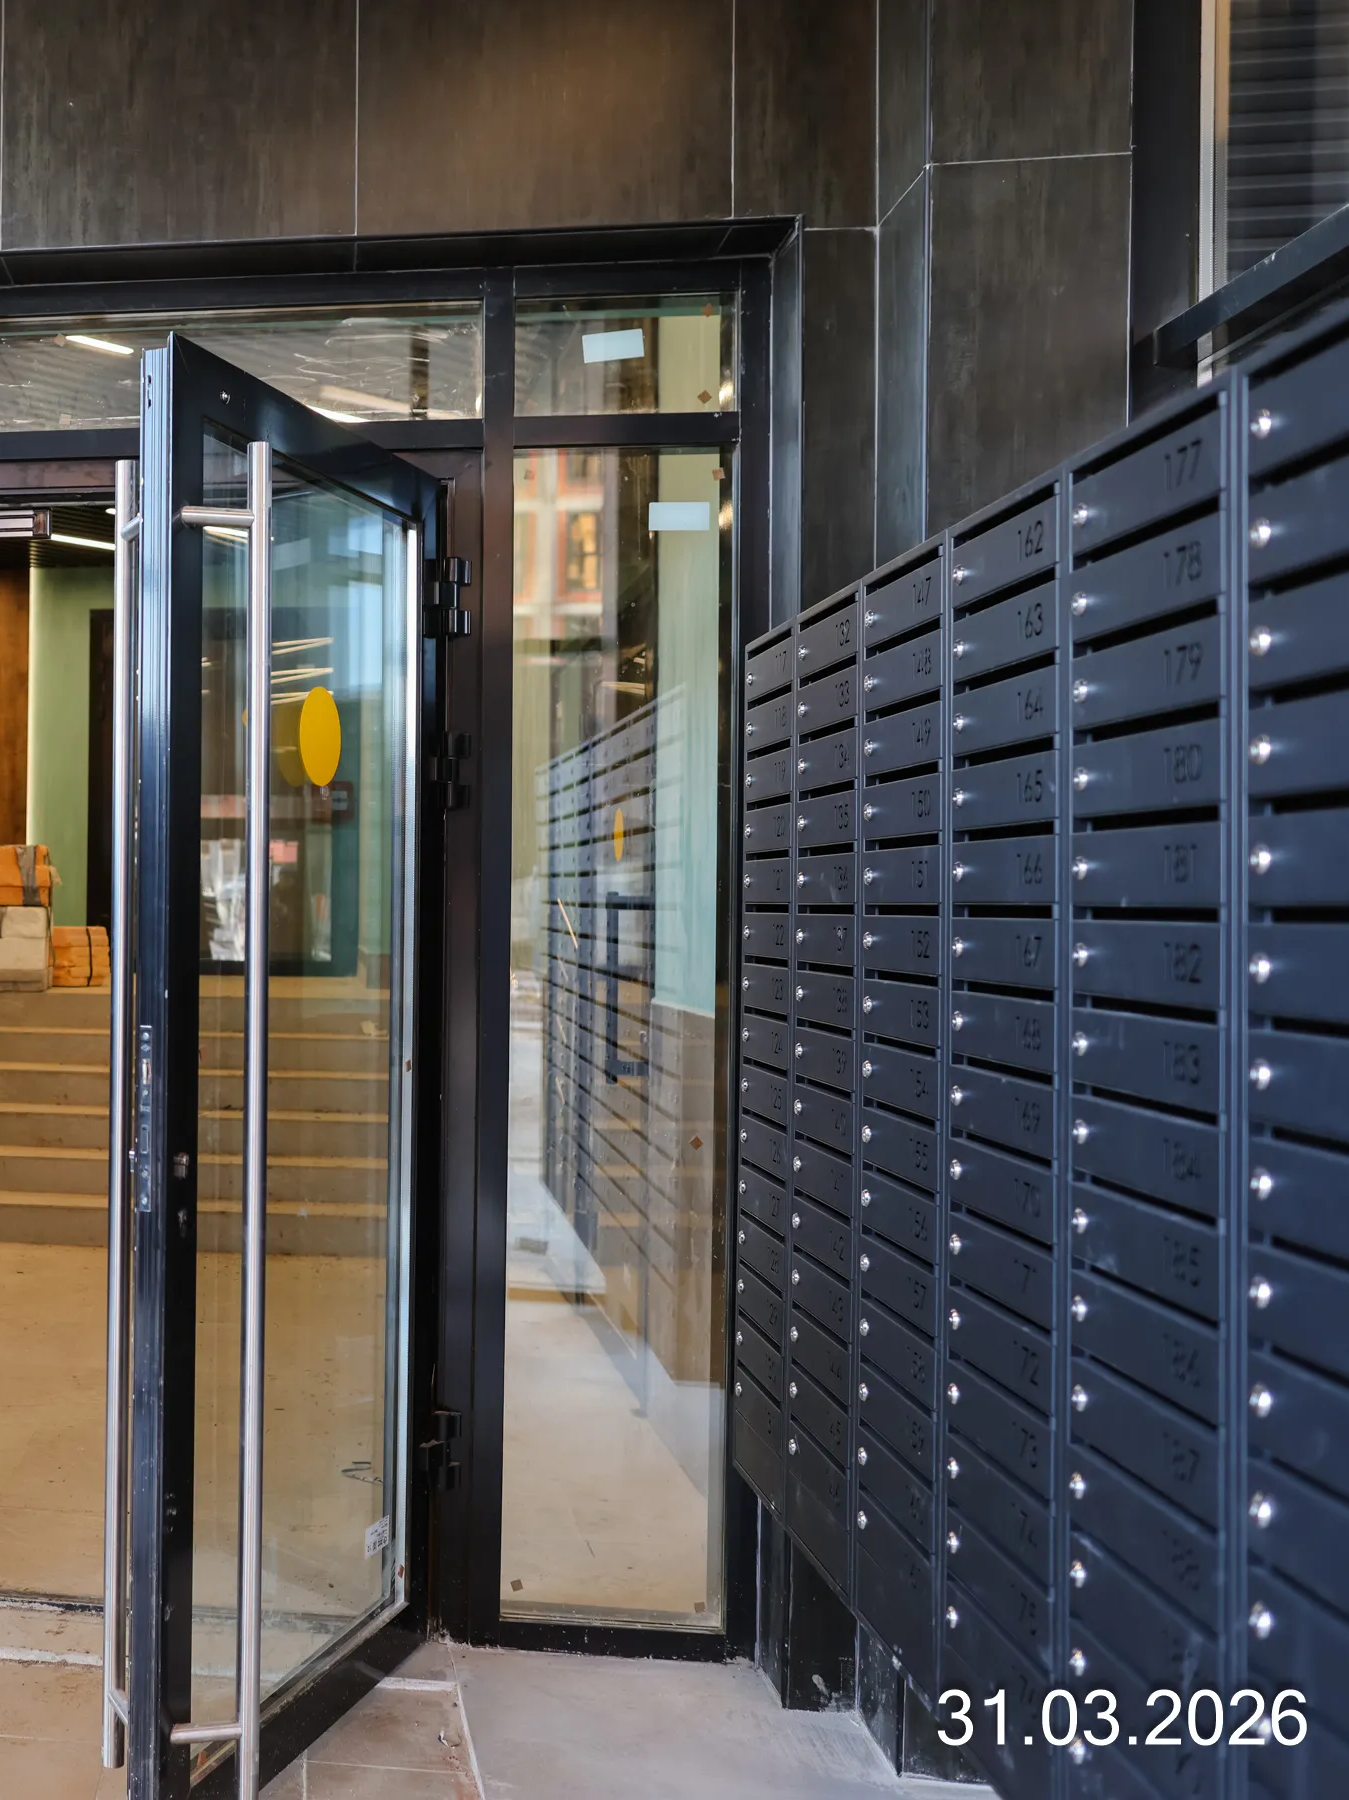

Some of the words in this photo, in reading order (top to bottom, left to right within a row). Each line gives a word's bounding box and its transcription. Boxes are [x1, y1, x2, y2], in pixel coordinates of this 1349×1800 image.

[1163, 439, 1202, 489] 177
[1017, 520, 1043, 561] 162
[1163, 542, 1200, 583] 178
[1017, 602, 1043, 637] 163
[1163, 642, 1200, 684] 179
[1016, 771, 1043, 802] 165
[1016, 853, 1042, 883] 166
